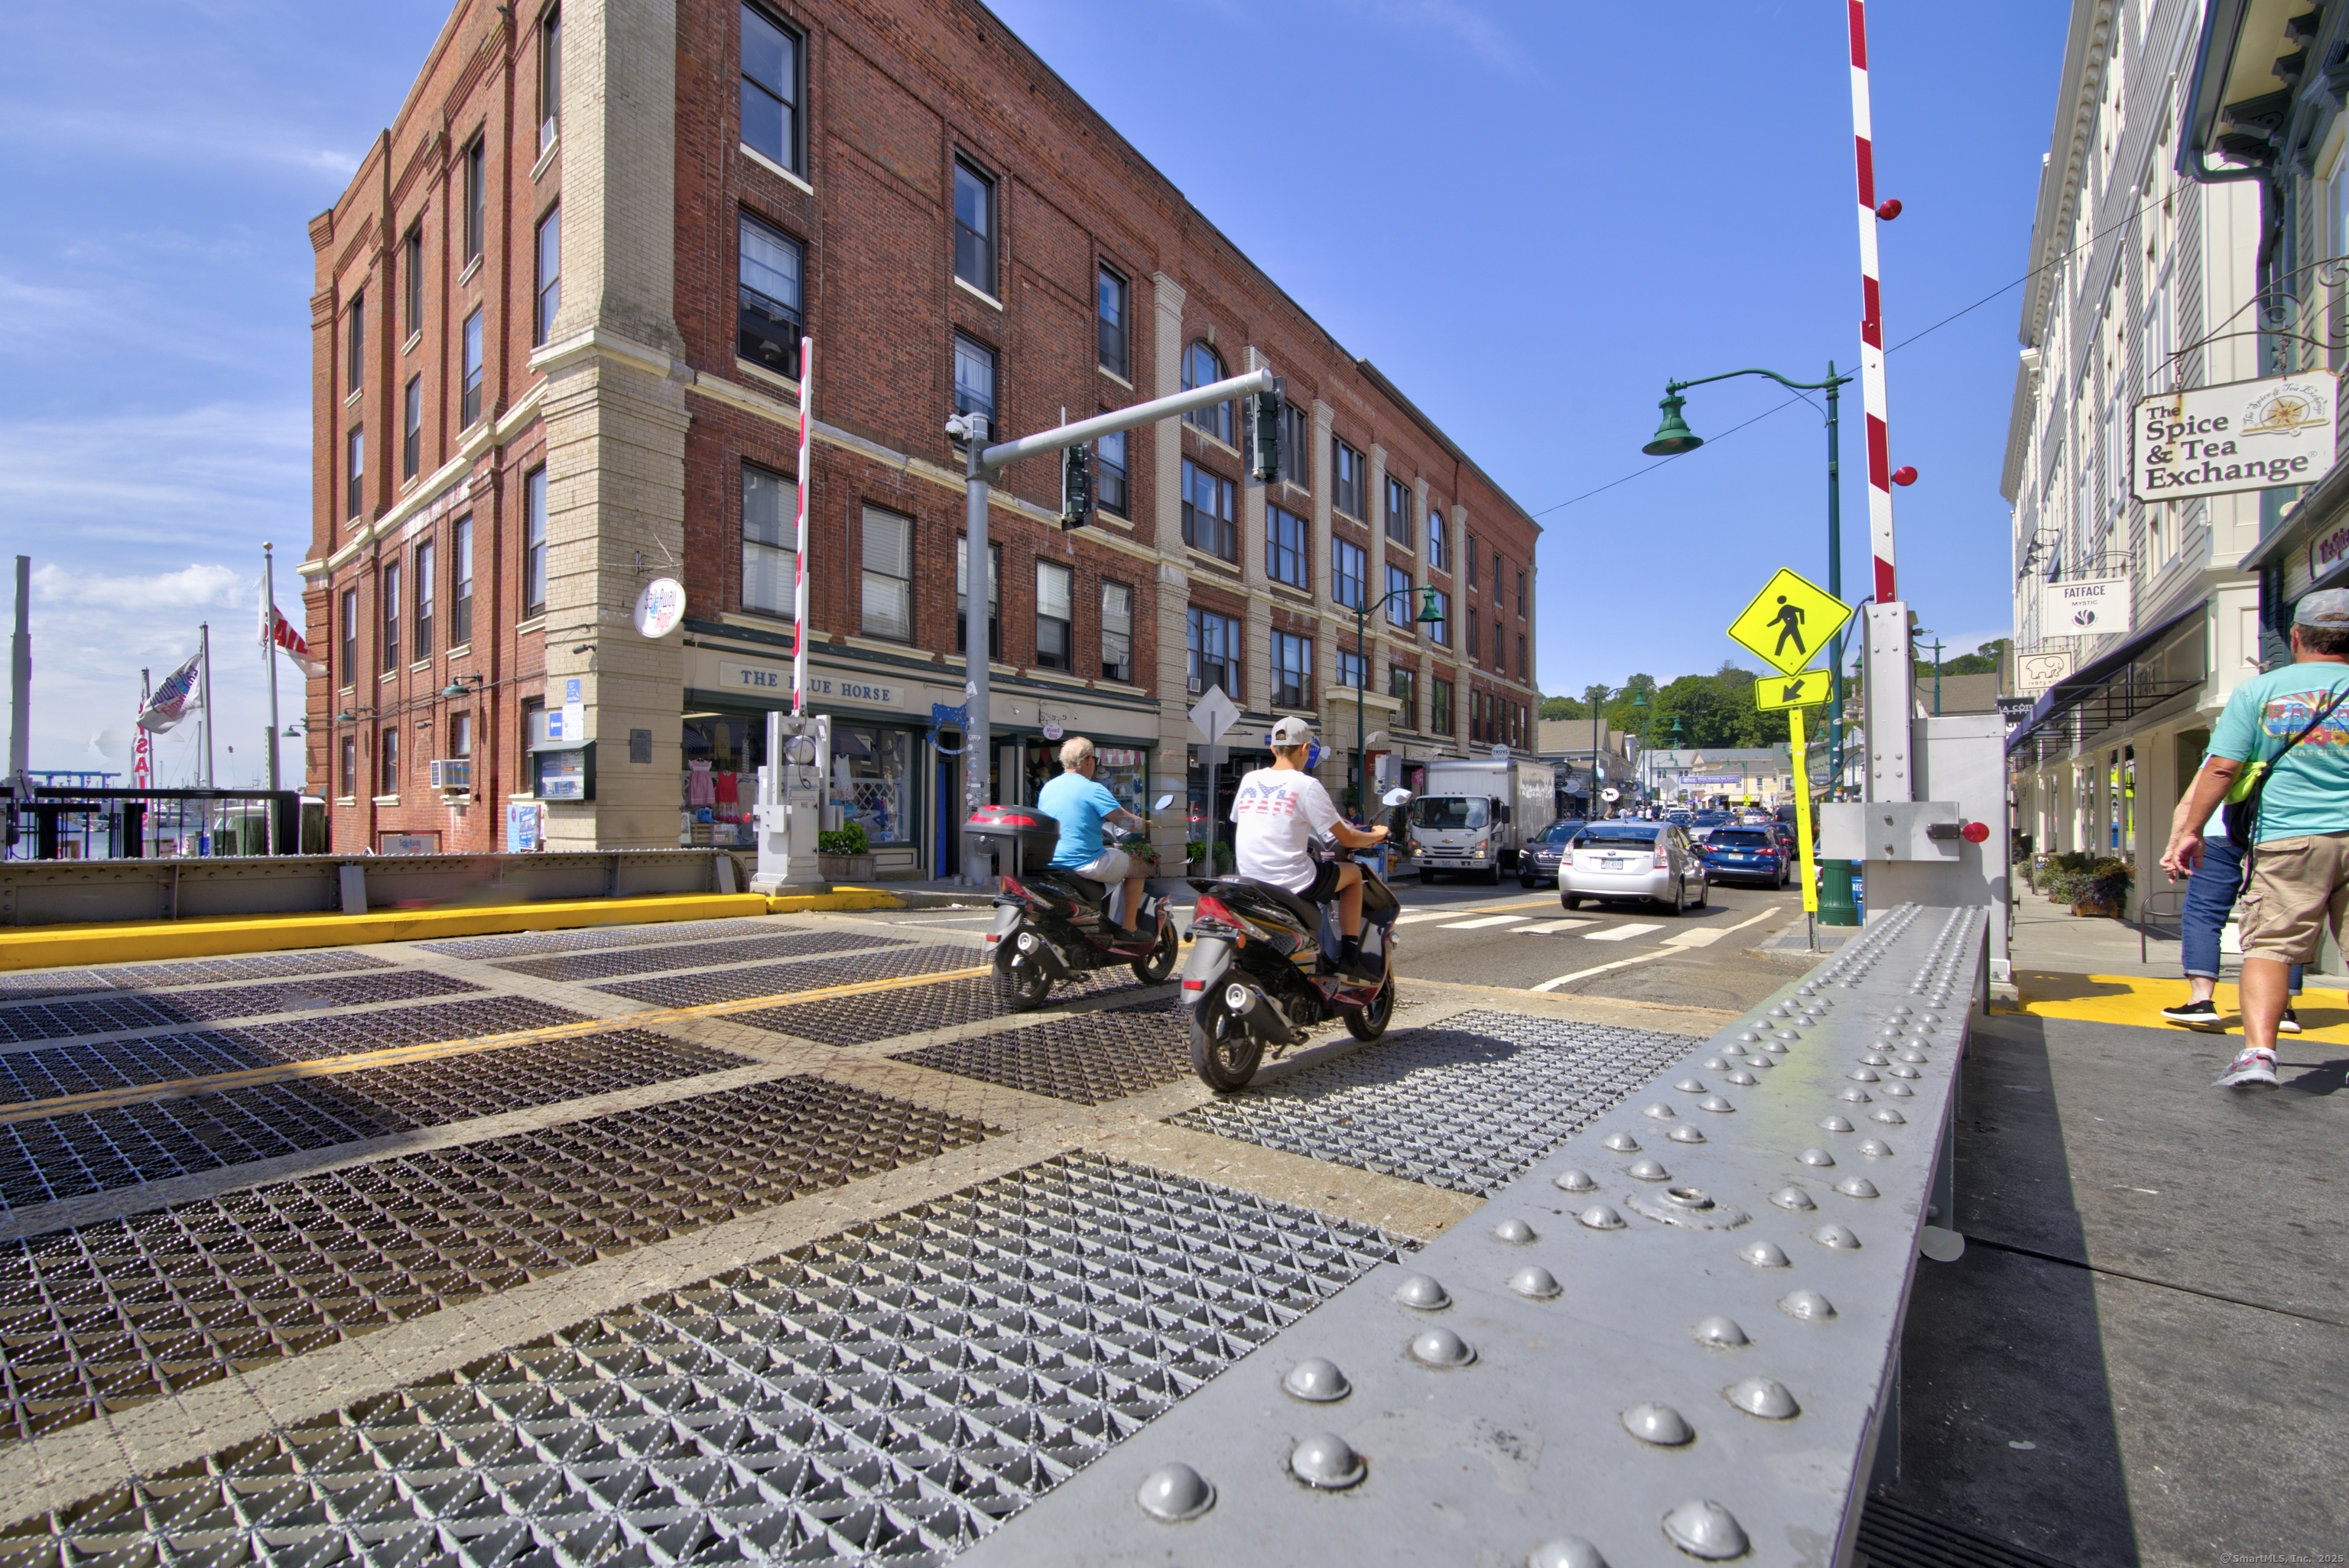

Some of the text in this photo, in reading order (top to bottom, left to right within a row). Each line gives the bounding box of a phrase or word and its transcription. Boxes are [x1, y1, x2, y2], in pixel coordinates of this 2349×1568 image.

[2247, 393, 2271, 410] Spice
[2282, 383, 2299, 391] Tea
[2146, 406, 2182, 420] The
[2146, 415, 2229, 445] Spice
[2146, 440, 2237, 465] & Tea
[2146, 455, 2308, 490] Exchange
[2065, 586, 2105, 598] FATFACE
[741, 670, 778, 687] THE
[841, 683, 890, 701] HORSE
